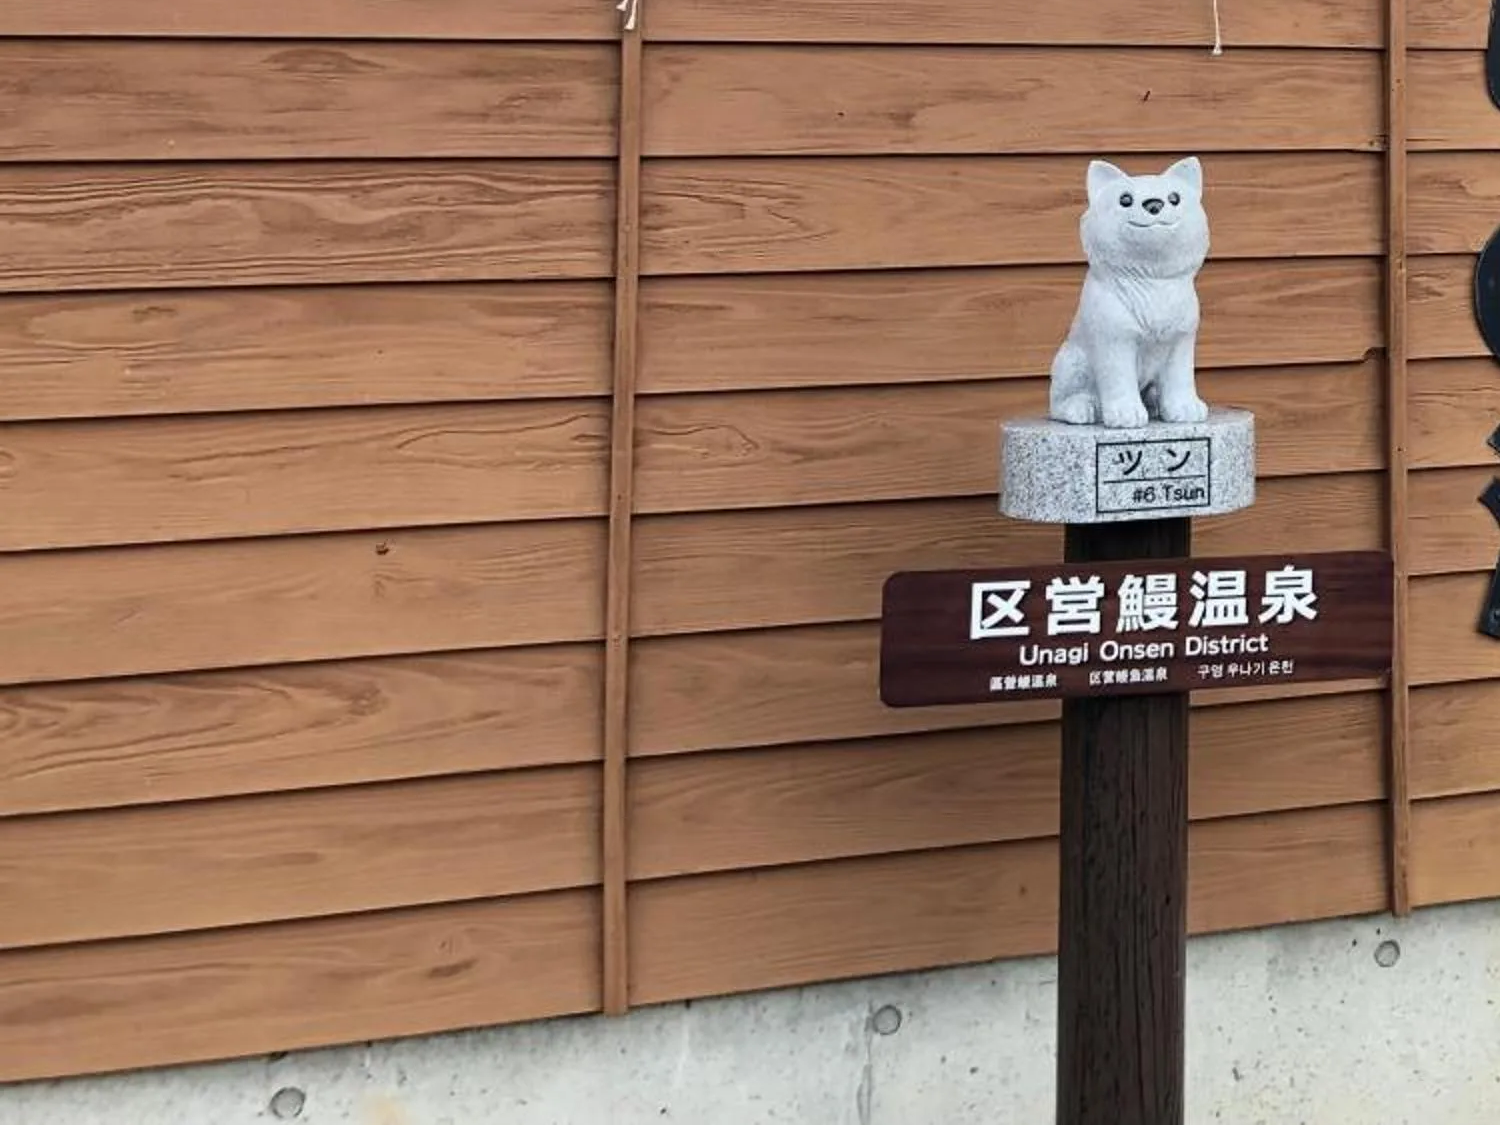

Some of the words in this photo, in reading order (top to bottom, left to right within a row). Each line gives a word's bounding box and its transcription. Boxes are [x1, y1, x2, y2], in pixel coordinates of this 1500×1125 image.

[1111, 449, 1191, 476] ツン
[1132, 485, 1156, 503] #6
[1162, 484, 1205, 501] Tsun
[968, 565, 1318, 641] 区営鰻温泉
[1019, 642, 1089, 666] Unagi
[1100, 640, 1175, 662] Onsen
[1185, 633, 1269, 656] District
